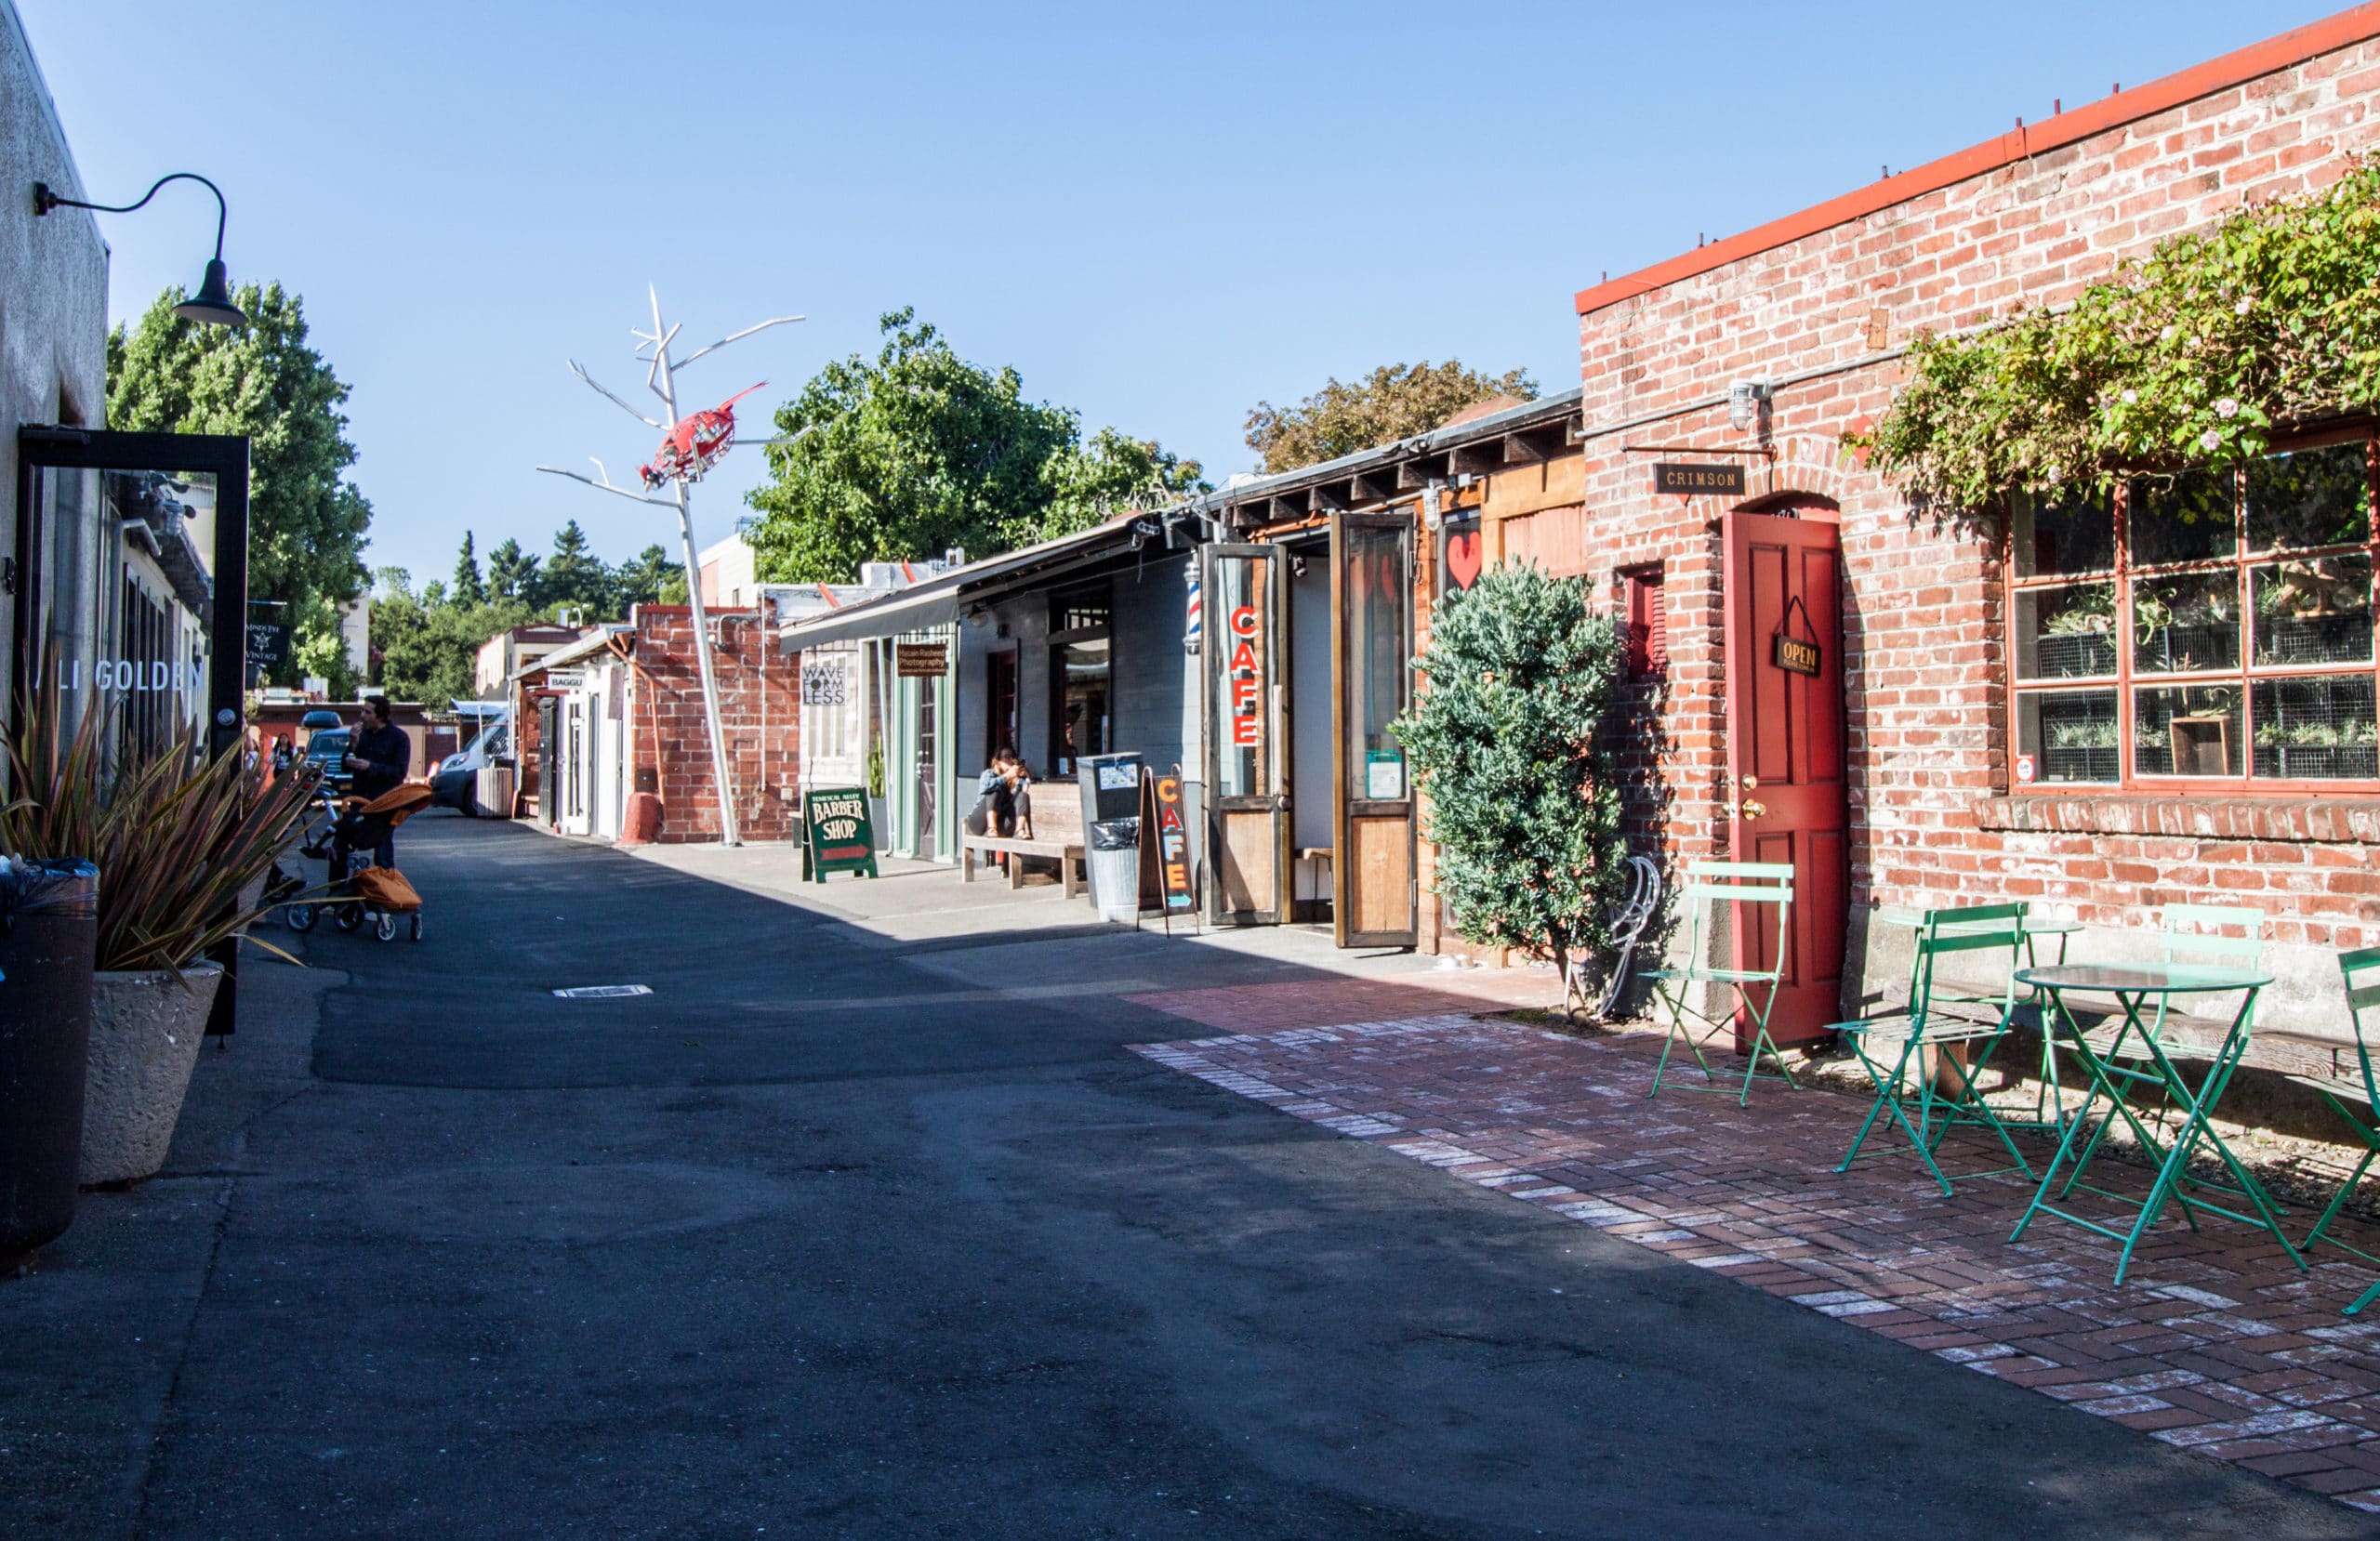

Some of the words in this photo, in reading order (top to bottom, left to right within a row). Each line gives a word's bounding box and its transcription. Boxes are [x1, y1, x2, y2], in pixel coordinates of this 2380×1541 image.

[1667, 471, 1736, 486] CRIMSON
[245, 651, 277, 661] VINTAGE
[1784, 642, 1816, 666] OPEN
[900, 658, 945, 668] Photography
[95, 659, 205, 691] GOLDEN
[803, 666, 844, 678] WAVE
[1230, 606, 1262, 746] CAFE
[803, 678, 844, 690] FORM
[803, 690, 844, 705] LESS
[812, 794, 840, 802] TEMESCAL
[813, 799, 866, 825] BARBER
[823, 819, 857, 841] SHOP
[1157, 779, 1188, 890] CAFE
